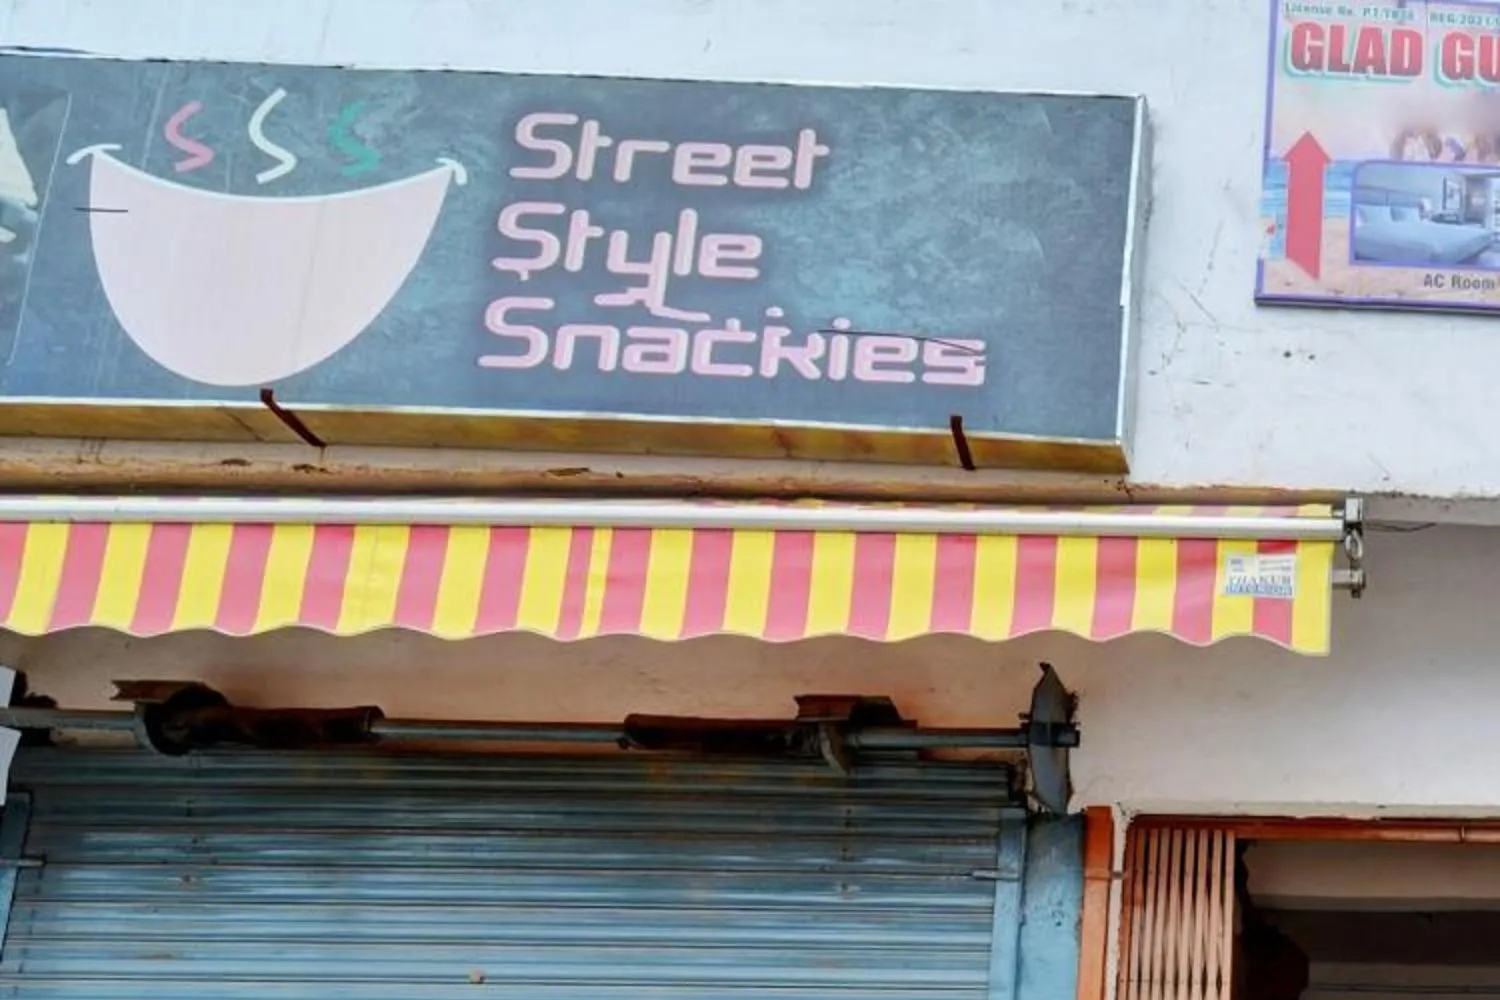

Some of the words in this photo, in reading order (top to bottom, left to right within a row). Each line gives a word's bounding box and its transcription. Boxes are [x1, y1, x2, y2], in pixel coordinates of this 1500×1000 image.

[1290, 21, 1424, 78] GLAD
[509, 112, 830, 189] Street
[492, 202, 763, 323] Style
[1423, 273, 1445, 289] AC
[1451, 274, 1495, 290] Room
[478, 296, 986, 387] Snackies
